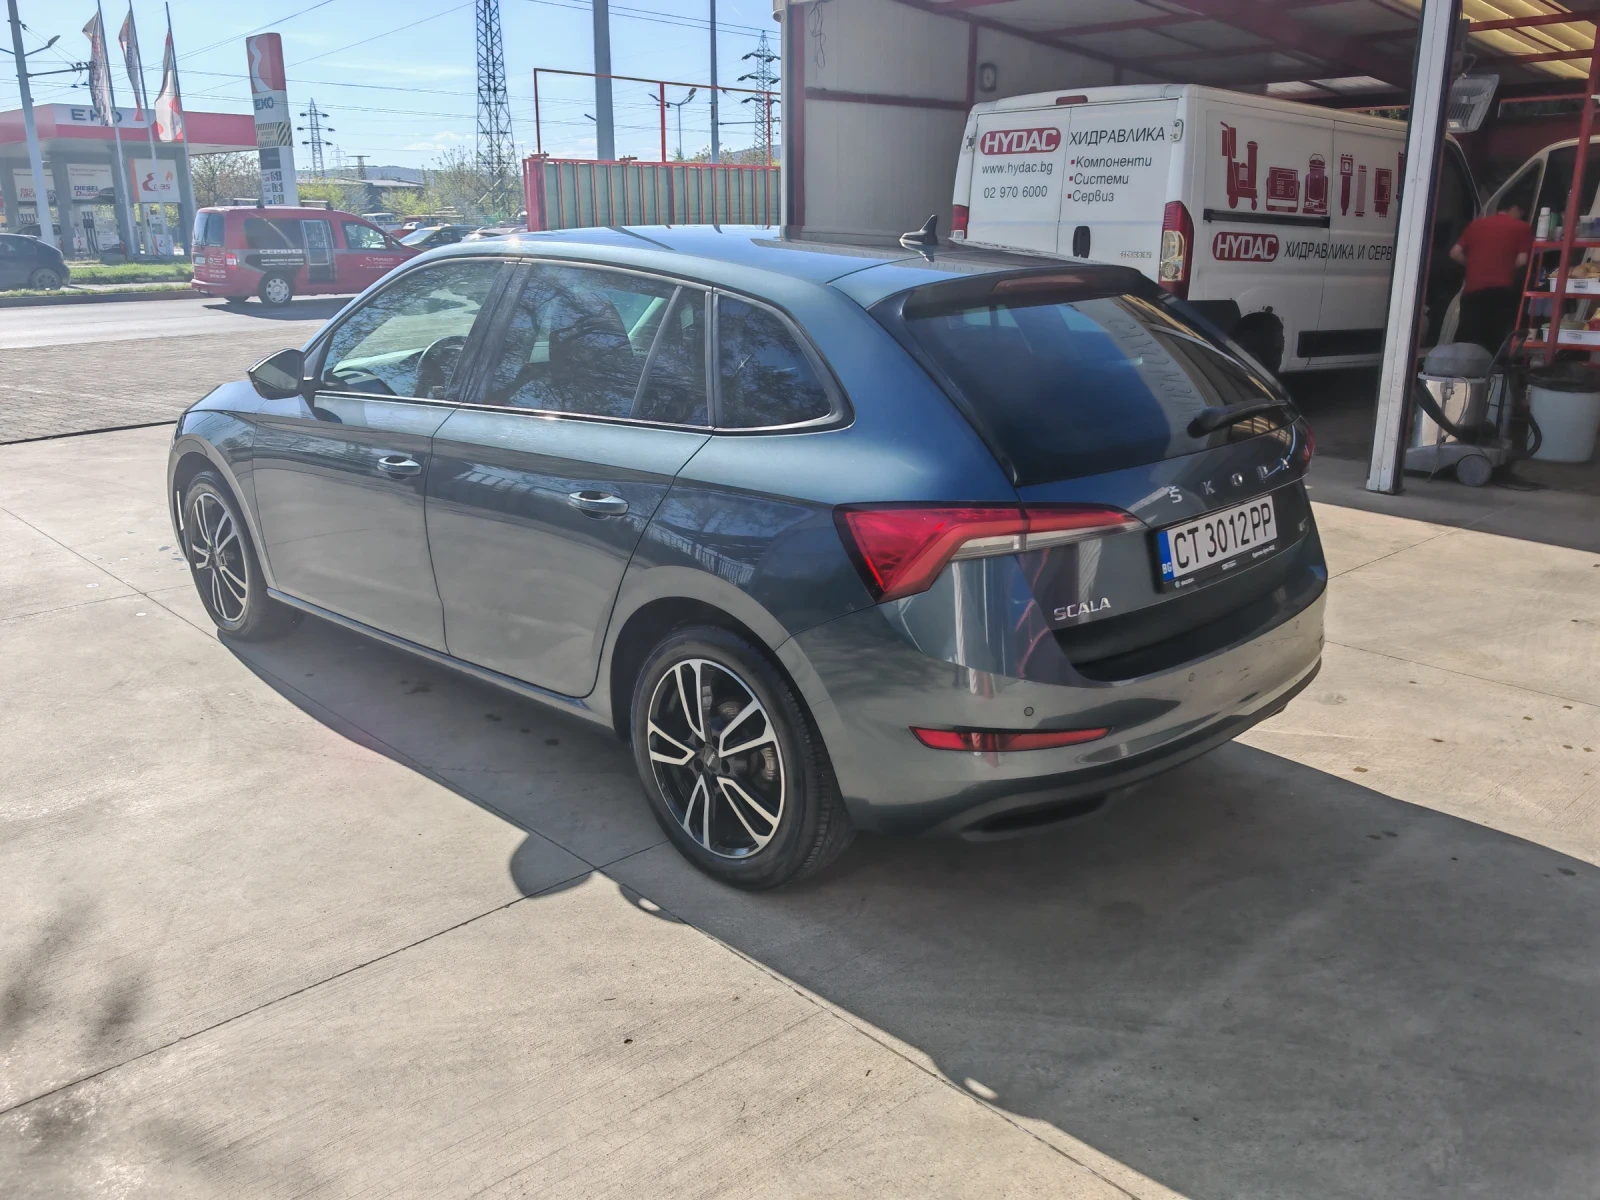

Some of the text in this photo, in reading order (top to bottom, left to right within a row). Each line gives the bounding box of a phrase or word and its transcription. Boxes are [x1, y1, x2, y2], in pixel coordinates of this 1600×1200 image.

[255, 96, 275, 111] EKO
[983, 129, 1058, 154] HYDAC
[1068, 126, 1165, 147] ХИДРАВЛИКА
[981, 160, 1053, 177] www.hydac.bg
[1075, 155, 1153, 169] Компоненти
[1074, 172, 1130, 186] Системи
[983, 185, 1048, 199] 02 970 6000
[1072, 189, 1115, 205] Сервиз
[1215, 234, 1277, 260] HYDAC
[1284, 240, 1393, 261] ХИДРАВЛИКА И СЕРВ
[1161, 561, 1173, 575] BG
[1053, 597, 1112, 621] SCALA
